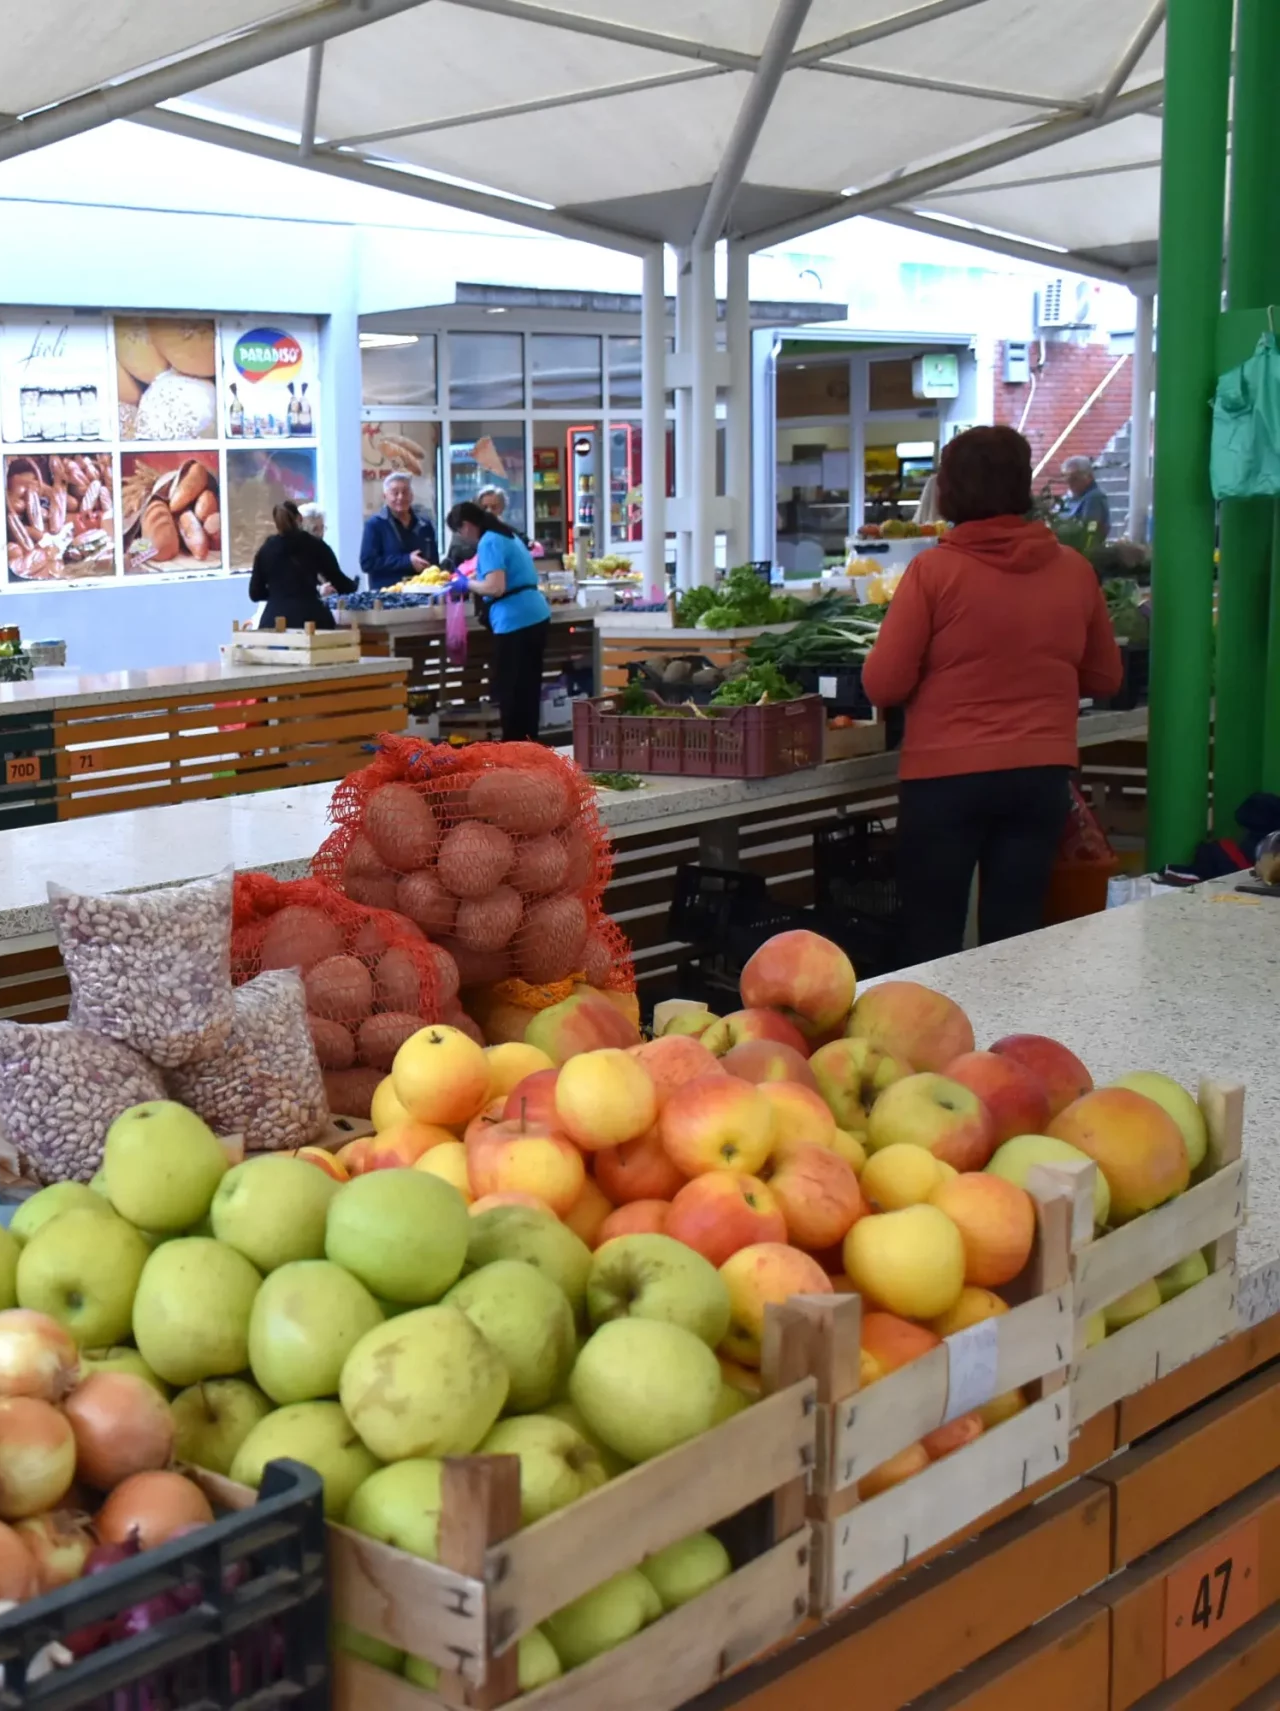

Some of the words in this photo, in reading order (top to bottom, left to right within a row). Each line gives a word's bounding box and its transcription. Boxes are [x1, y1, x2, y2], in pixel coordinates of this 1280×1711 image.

[239, 346, 298, 363] PARADISO
[10, 762, 35, 778] 70D
[1191, 1556, 1233, 1630] 47
